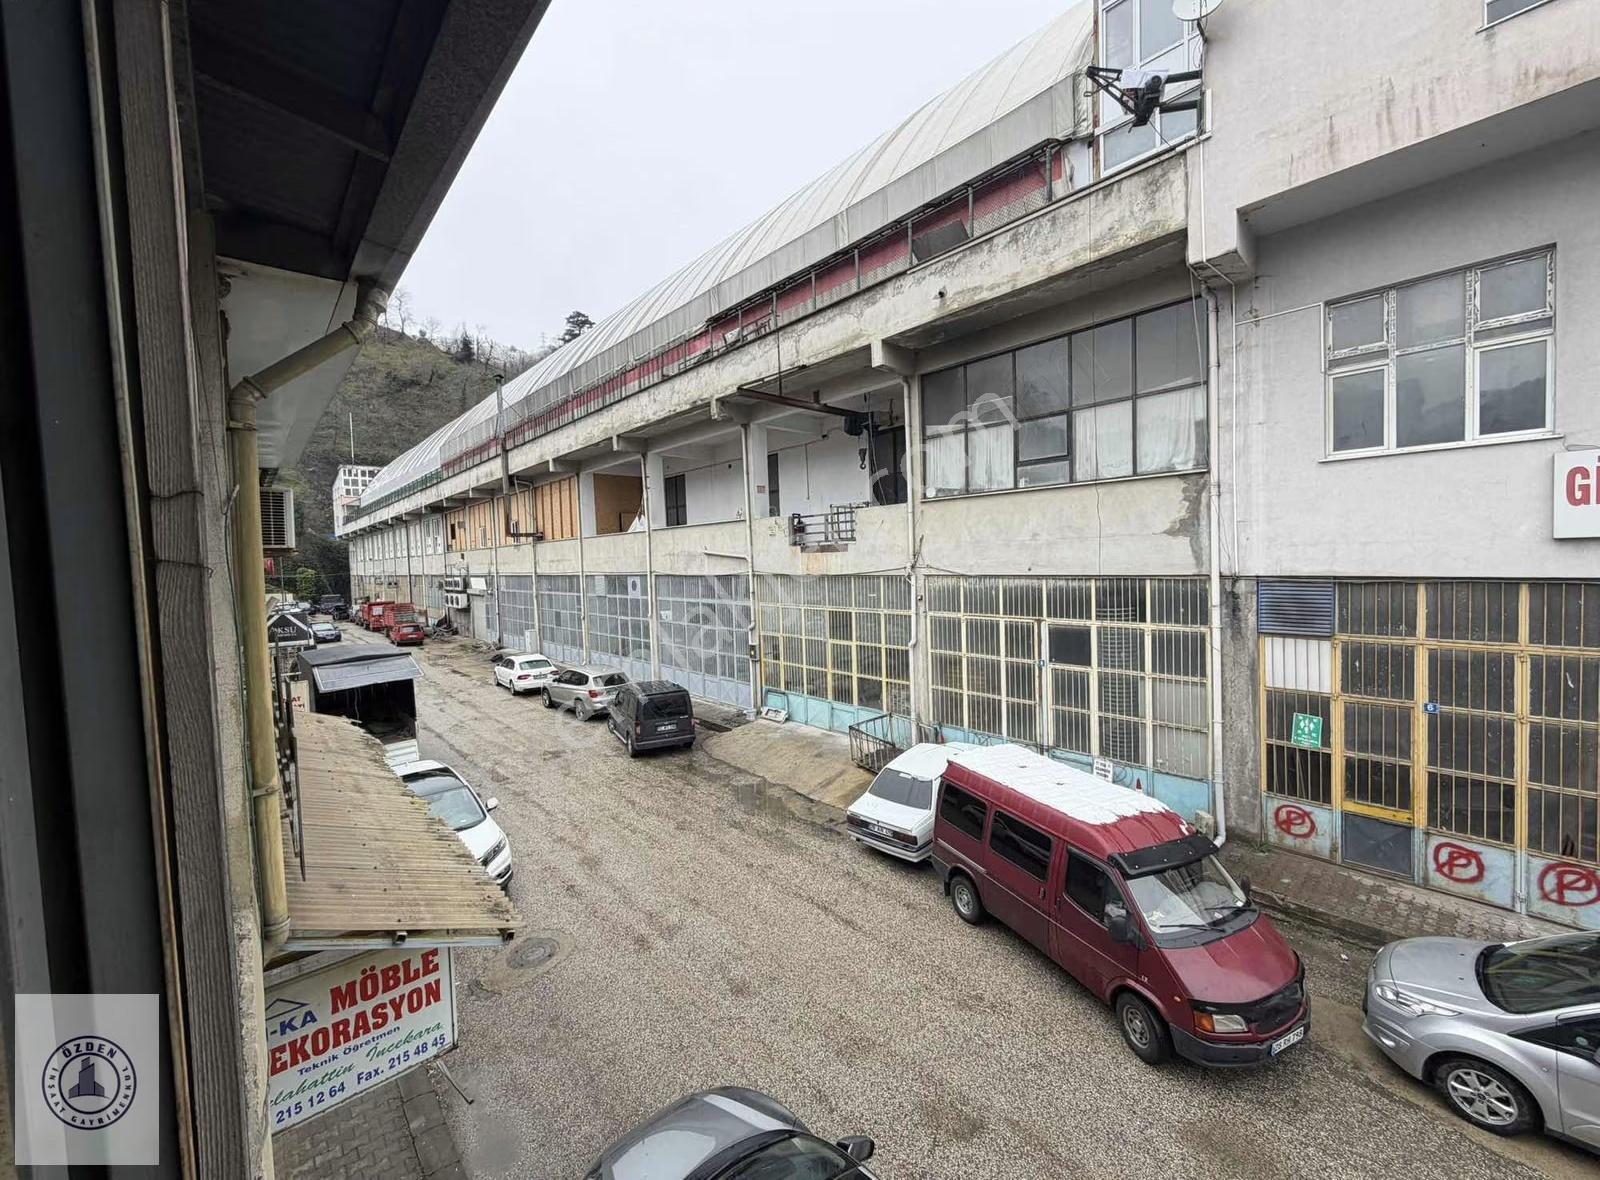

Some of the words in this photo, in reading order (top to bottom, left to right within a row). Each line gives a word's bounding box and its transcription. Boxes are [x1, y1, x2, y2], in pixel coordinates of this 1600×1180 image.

[330, 948, 439, 1015] MÖBLE
[270, 978, 441, 1076] EKORASYON
[297, 1053, 339, 1076] Teknik
[276, 1101, 303, 1124] 215
[308, 1091, 325, 1108] 12
[329, 1080, 346, 1098] 64
[357, 1066, 384, 1085] Fax.
[388, 1050, 410, 1070] 215
[413, 1041, 428, 1057] 48
[431, 1033, 446, 1048] 45
